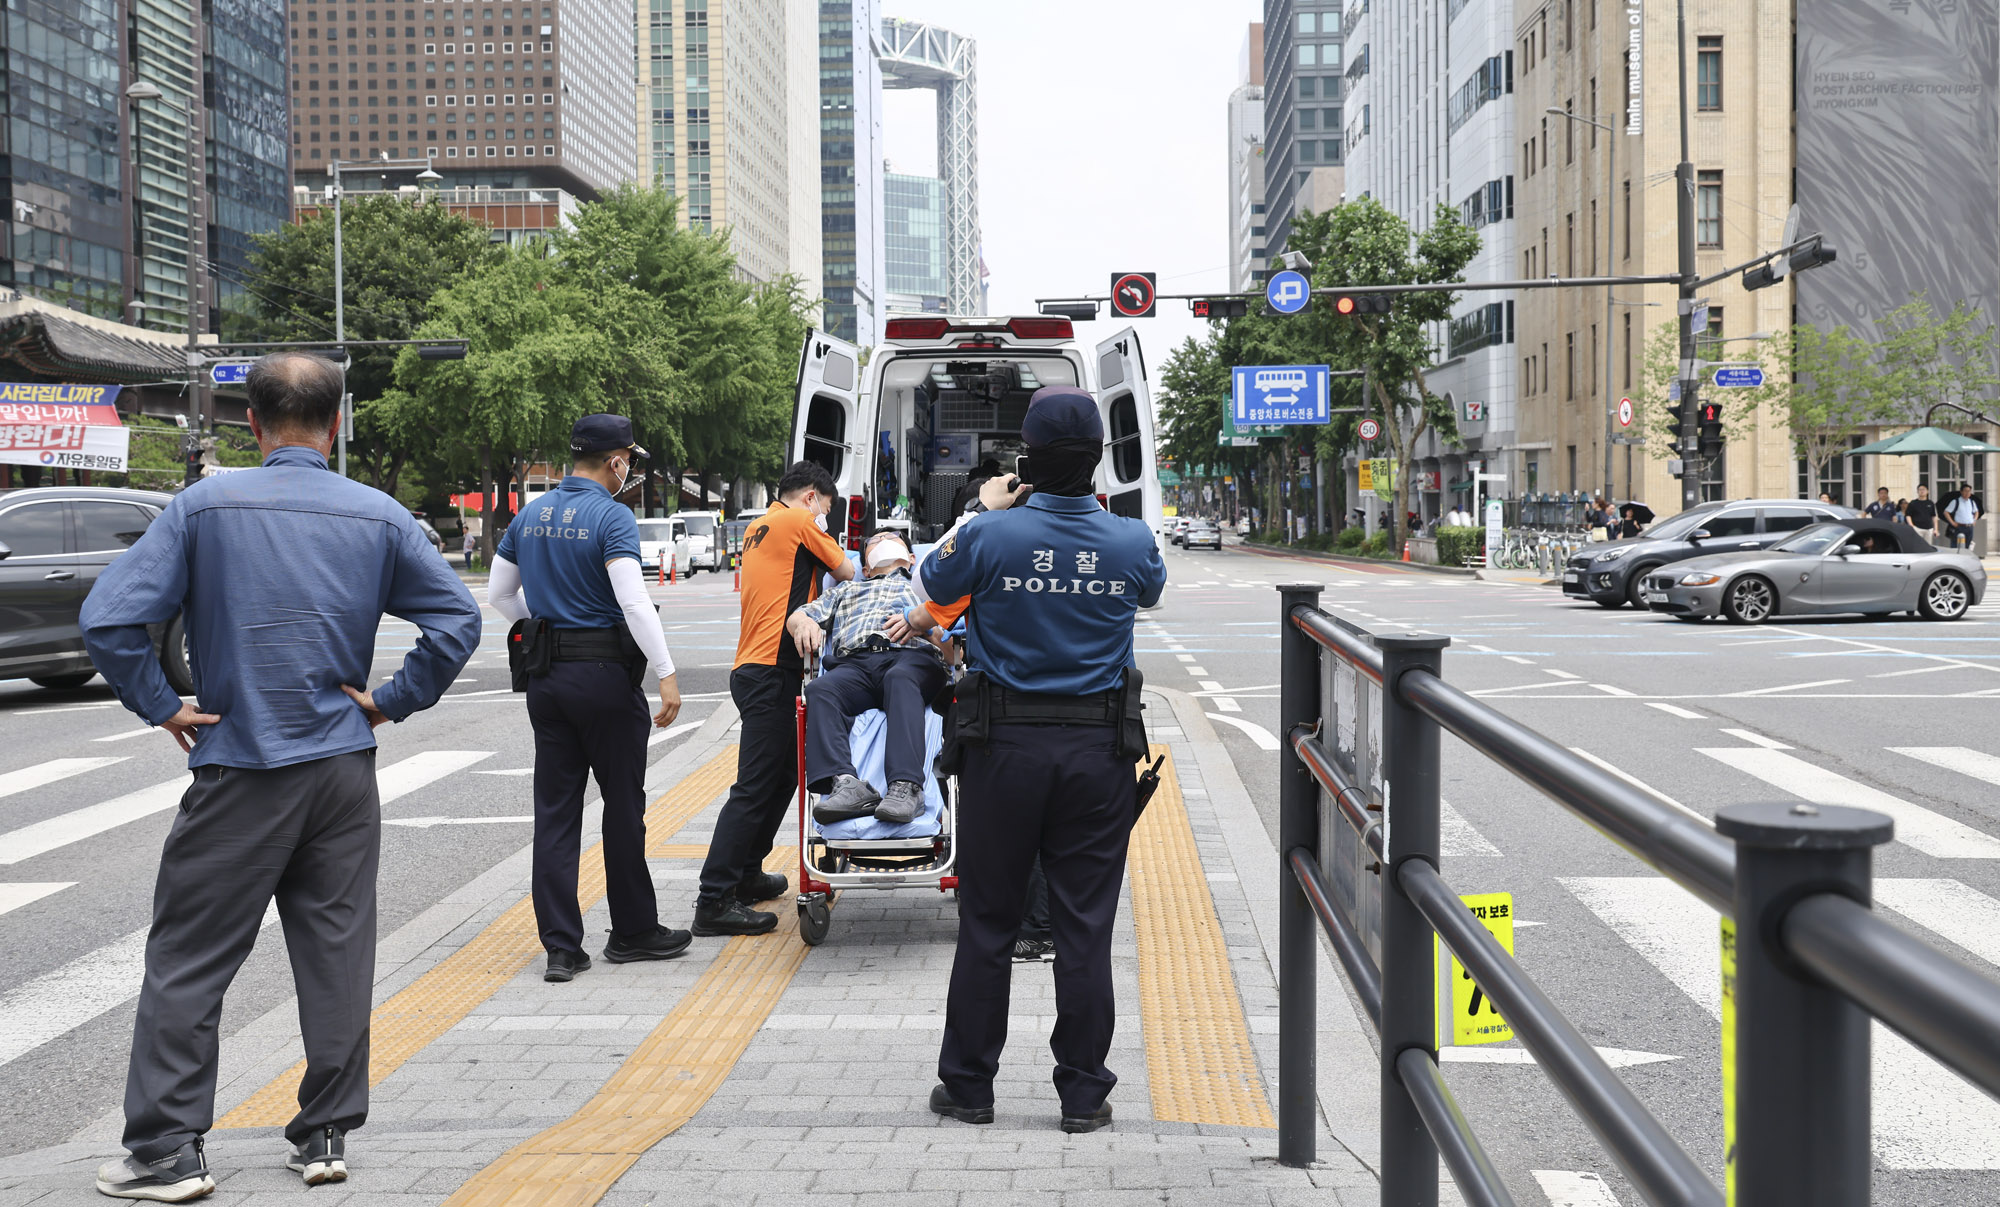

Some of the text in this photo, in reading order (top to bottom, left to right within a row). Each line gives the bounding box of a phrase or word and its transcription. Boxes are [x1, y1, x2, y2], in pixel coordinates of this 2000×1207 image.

[1626, 8, 1641, 25] of
[1628, 28, 1641, 94] museum
[1814, 71, 1876, 82] HYEIN SEO
[1813, 83, 1984, 96] POST ARCHIVE FACTION (PAF)
[1813, 98, 1878, 109] JIYONGKIM
[1855, 252, 1868, 271] 5
[236, 366, 251, 375] 세종
[0, 385, 105, 403] 사라집니까?
[0, 404, 89, 422] 말입니까!
[1249, 408, 1314, 421] 중앙차로버스전용
[1362, 425, 1375, 435] 50
[57, 452, 122, 470] 자유통일당
[523, 525, 590, 540] POLICE
[1002, 576, 1126, 595] POLICE
[1489, 904, 1509, 919] 보호
